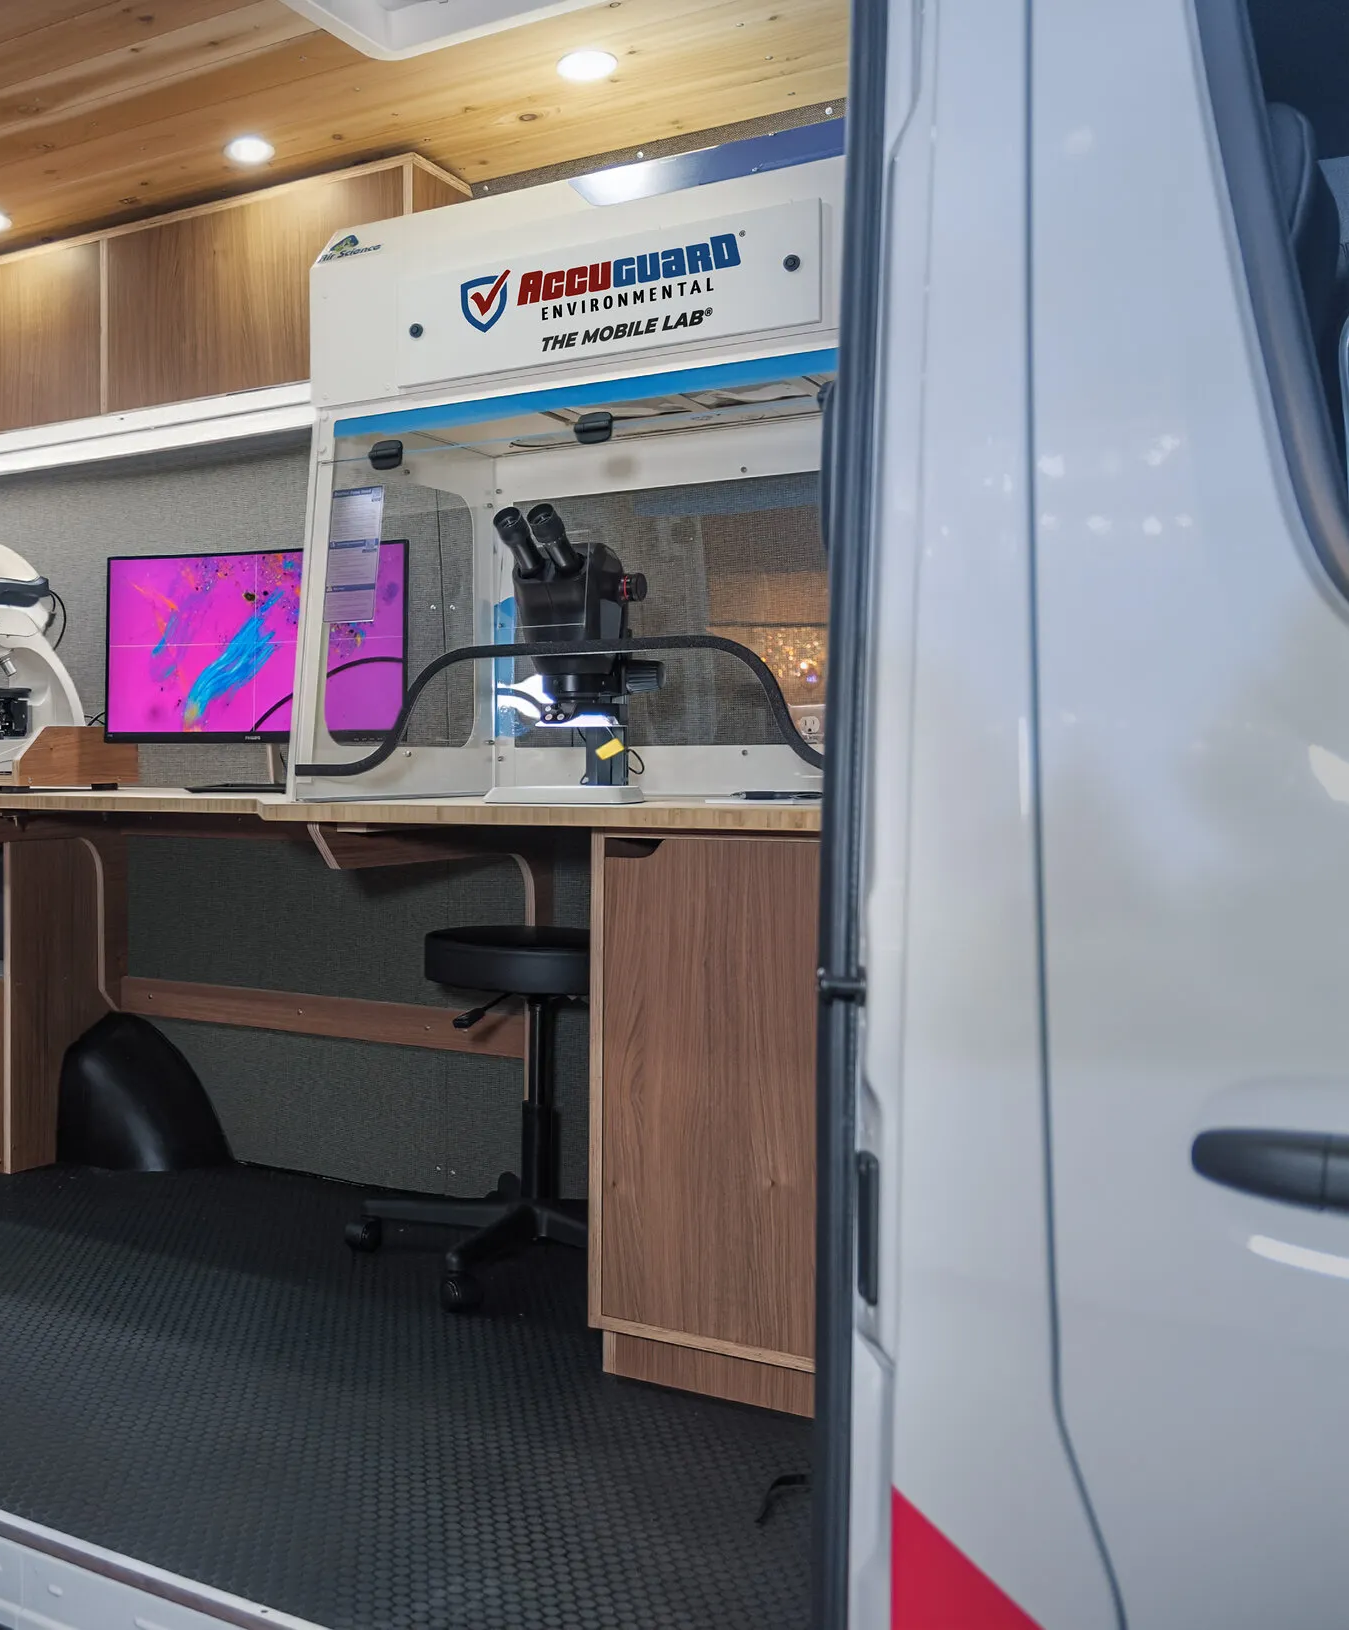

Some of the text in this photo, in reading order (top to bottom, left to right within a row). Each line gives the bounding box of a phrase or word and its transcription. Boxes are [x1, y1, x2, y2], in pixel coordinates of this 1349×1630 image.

[337, 244, 382, 258] Science
[540, 278, 715, 320] ENVIRONMENTAL
[542, 332, 579, 352] THE
[581, 312, 659, 346] MOBILE
